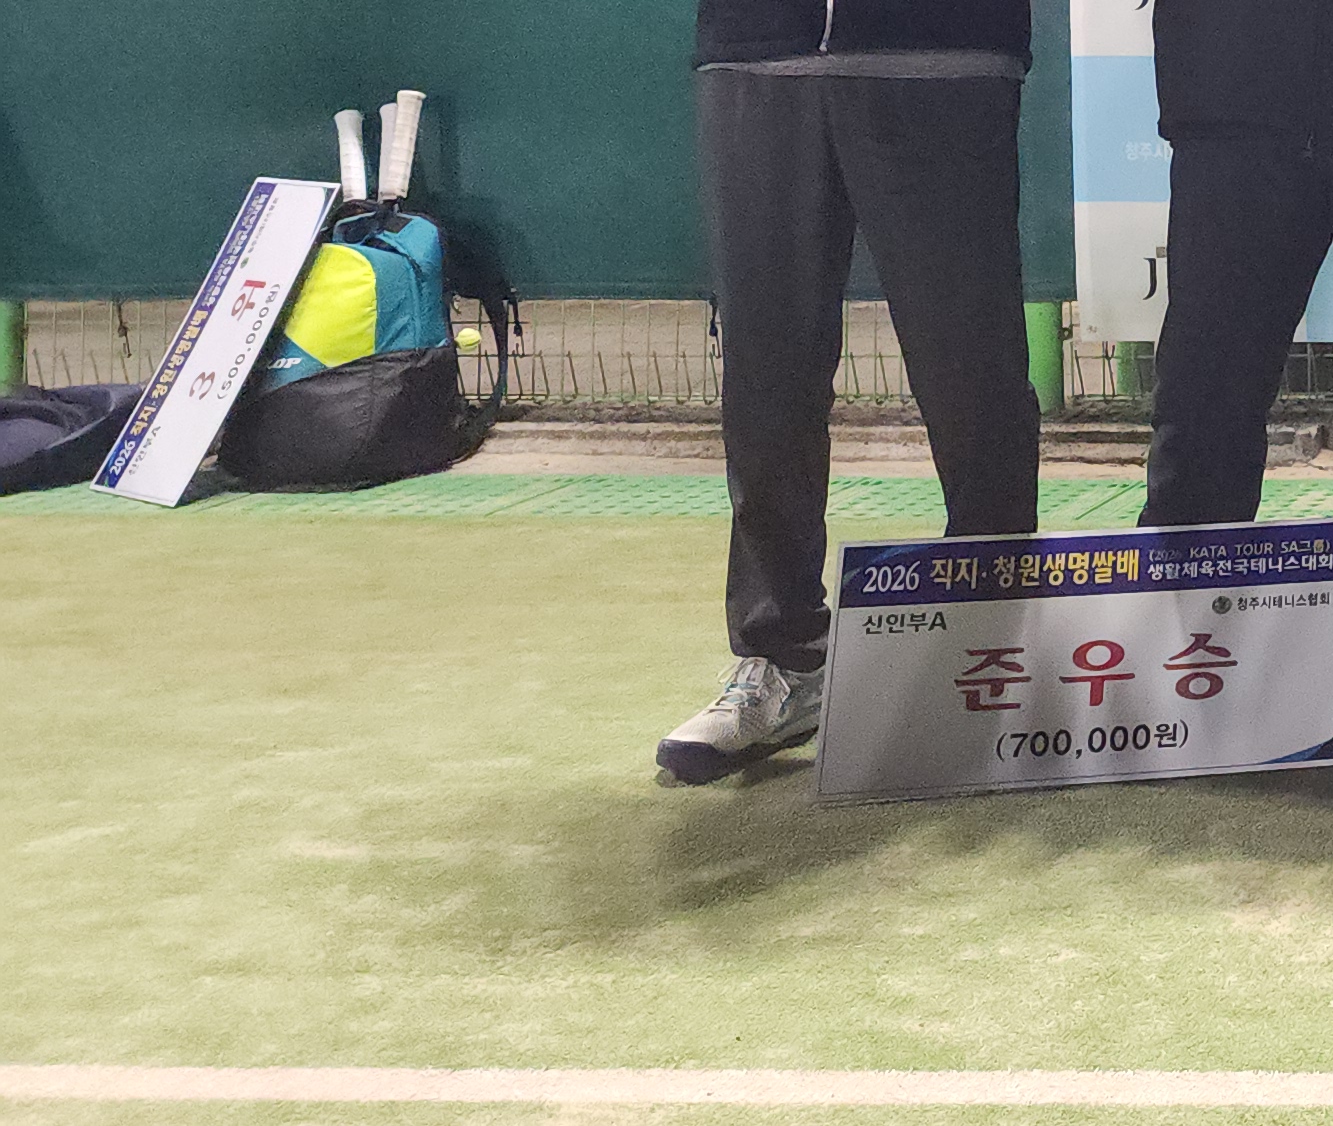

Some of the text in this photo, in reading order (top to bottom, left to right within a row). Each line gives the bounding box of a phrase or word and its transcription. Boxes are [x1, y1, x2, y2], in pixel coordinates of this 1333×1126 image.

[189, 371, 216, 400] 3
[231, 279, 267, 321] 위
[109, 440, 137, 476] 2026
[1189, 544, 1227, 559] KATA
[1234, 541, 1274, 556] TOUR
[862, 560, 921, 594] 2026
[1147, 554, 1333, 581] 생활체육전국테니스대회
[1237, 592, 1331, 611] 청주시테니스협회
[862, 611, 947, 635] 신인부A
[996, 719, 1189, 761] (700,000원)
